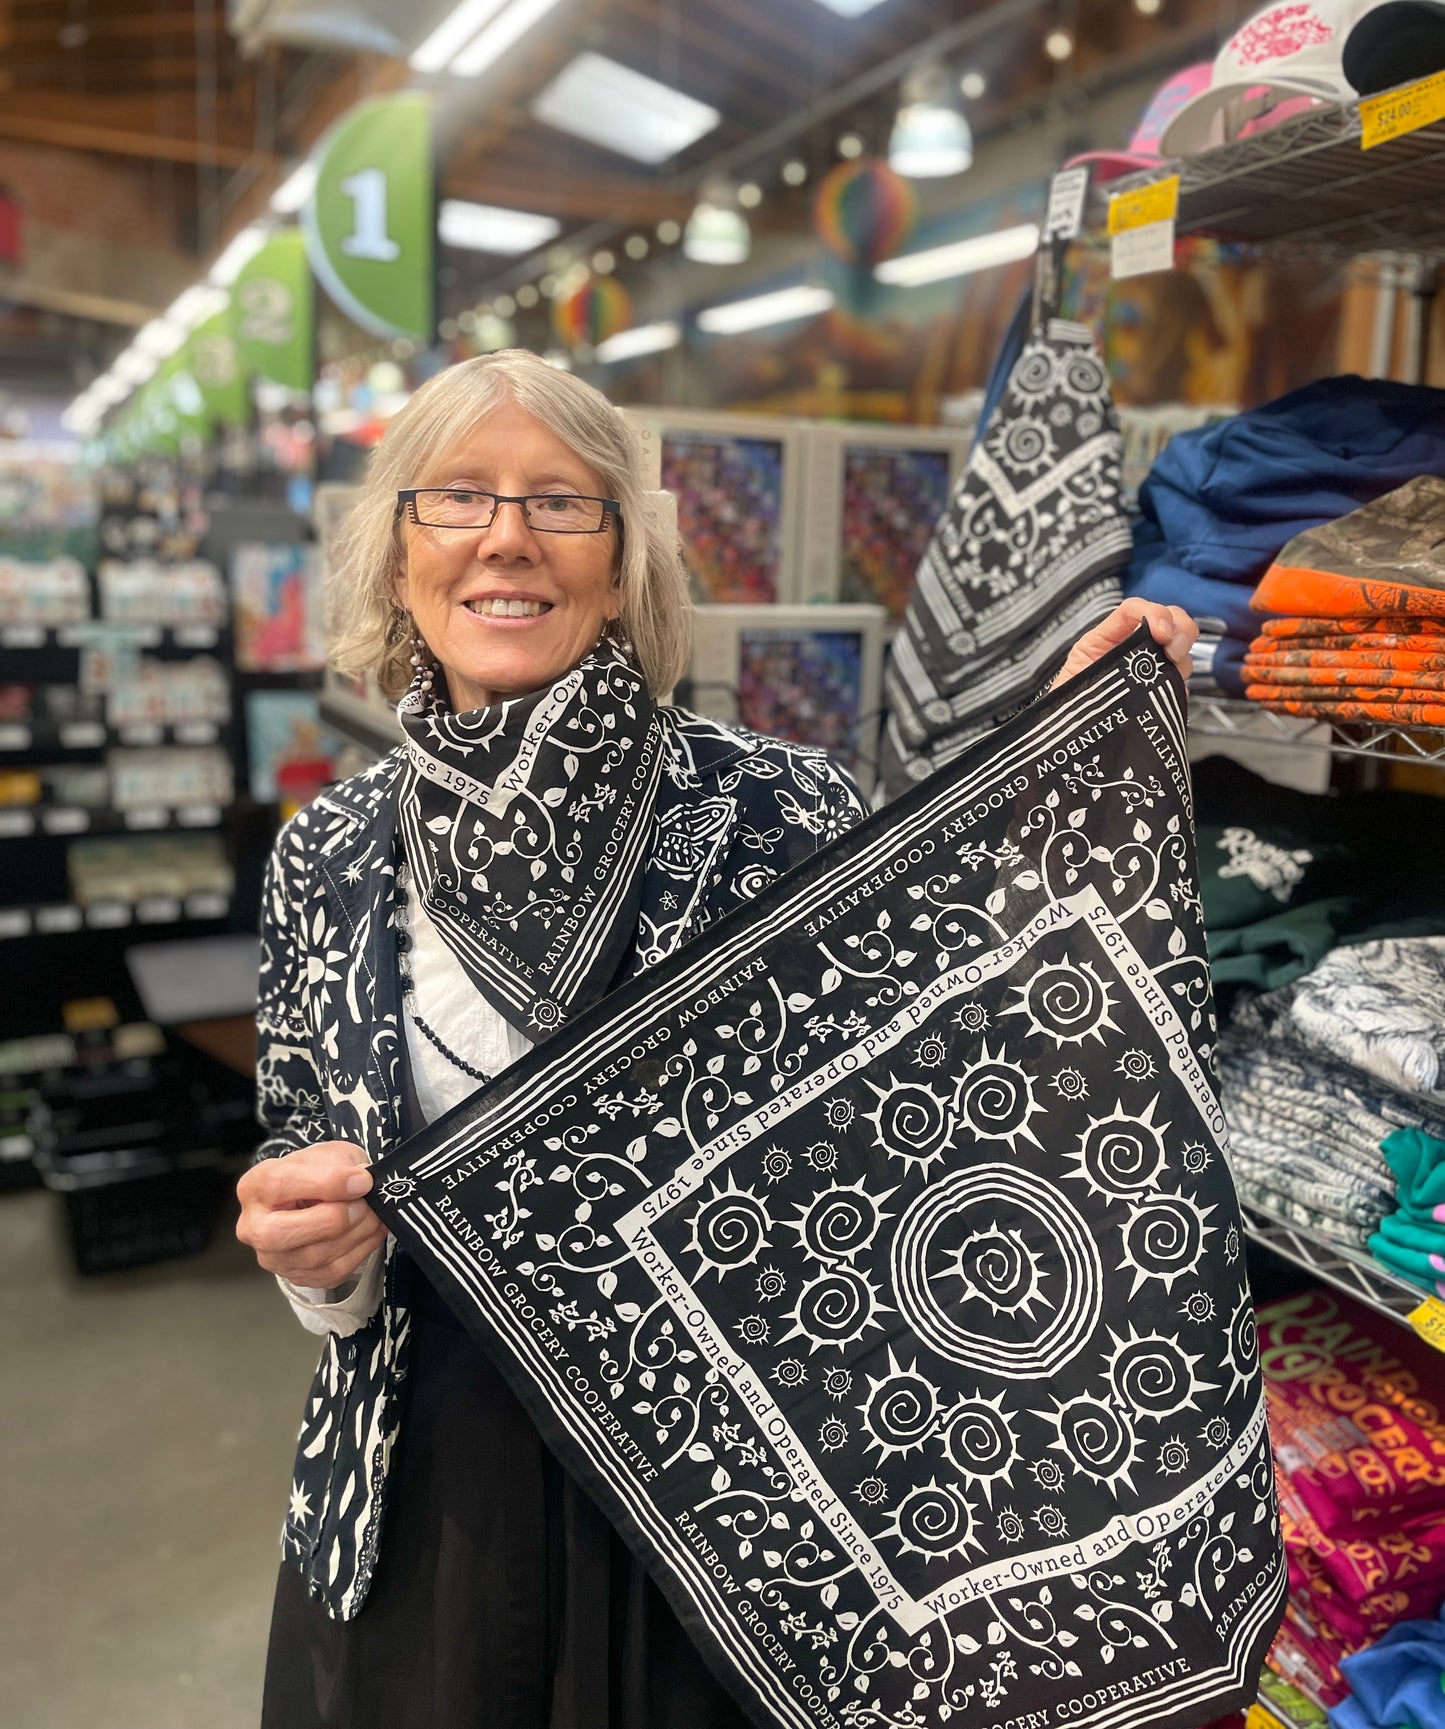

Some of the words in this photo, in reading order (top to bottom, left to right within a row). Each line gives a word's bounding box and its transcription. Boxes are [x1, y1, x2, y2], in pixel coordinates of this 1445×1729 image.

[343, 168, 399, 261] 1
[240, 279, 293, 343] 2
[1036, 708, 1129, 779] RAINBOW
[443, 771, 490, 806] 1975
[941, 775, 1030, 843] GROCERY
[538, 885, 597, 976] RAINBOW
[594, 793, 636, 882] GROCERY
[803, 839, 936, 938] COOPERATIVE
[906, 902, 1074, 1026] Worker-Owned
[1088, 906, 1129, 959] 1975
[678, 956, 769, 1029] RAINBOW
[1126, 962, 1173, 1027] Since
[583, 1026, 672, 1096] GROCERY
[861, 1020, 902, 1058] and
[754, 1054, 859, 1130] Operated
[1166, 1028, 1226, 1135] Operated
[441, 1094, 578, 1191] COOPERATIVE
[691, 1122, 752, 1170] Since
[642, 1174, 694, 1219] 1975
[435, 1195, 508, 1278] RAINBOW
[503, 1282, 570, 1362] GROCERY
[565, 1365, 660, 1484] COOPERATIVE
[631, 1228, 745, 1377] Worker-Owned
[739, 1377, 776, 1421] and
[767, 1419, 838, 1515] Operated
[829, 1512, 872, 1567] Since
[869, 1565, 906, 1611] 1975
[924, 1547, 1087, 1615] Worker-Owned
[1092, 1519, 1134, 1557] and
[1135, 1457, 1236, 1538] Operated
[675, 1510, 742, 1596] RAINBOW
[737, 1599, 797, 1674] GROCERY
[1215, 1552, 1278, 1642] RAINBOW
[1055, 1656, 1193, 1718] COOPERATIVE
